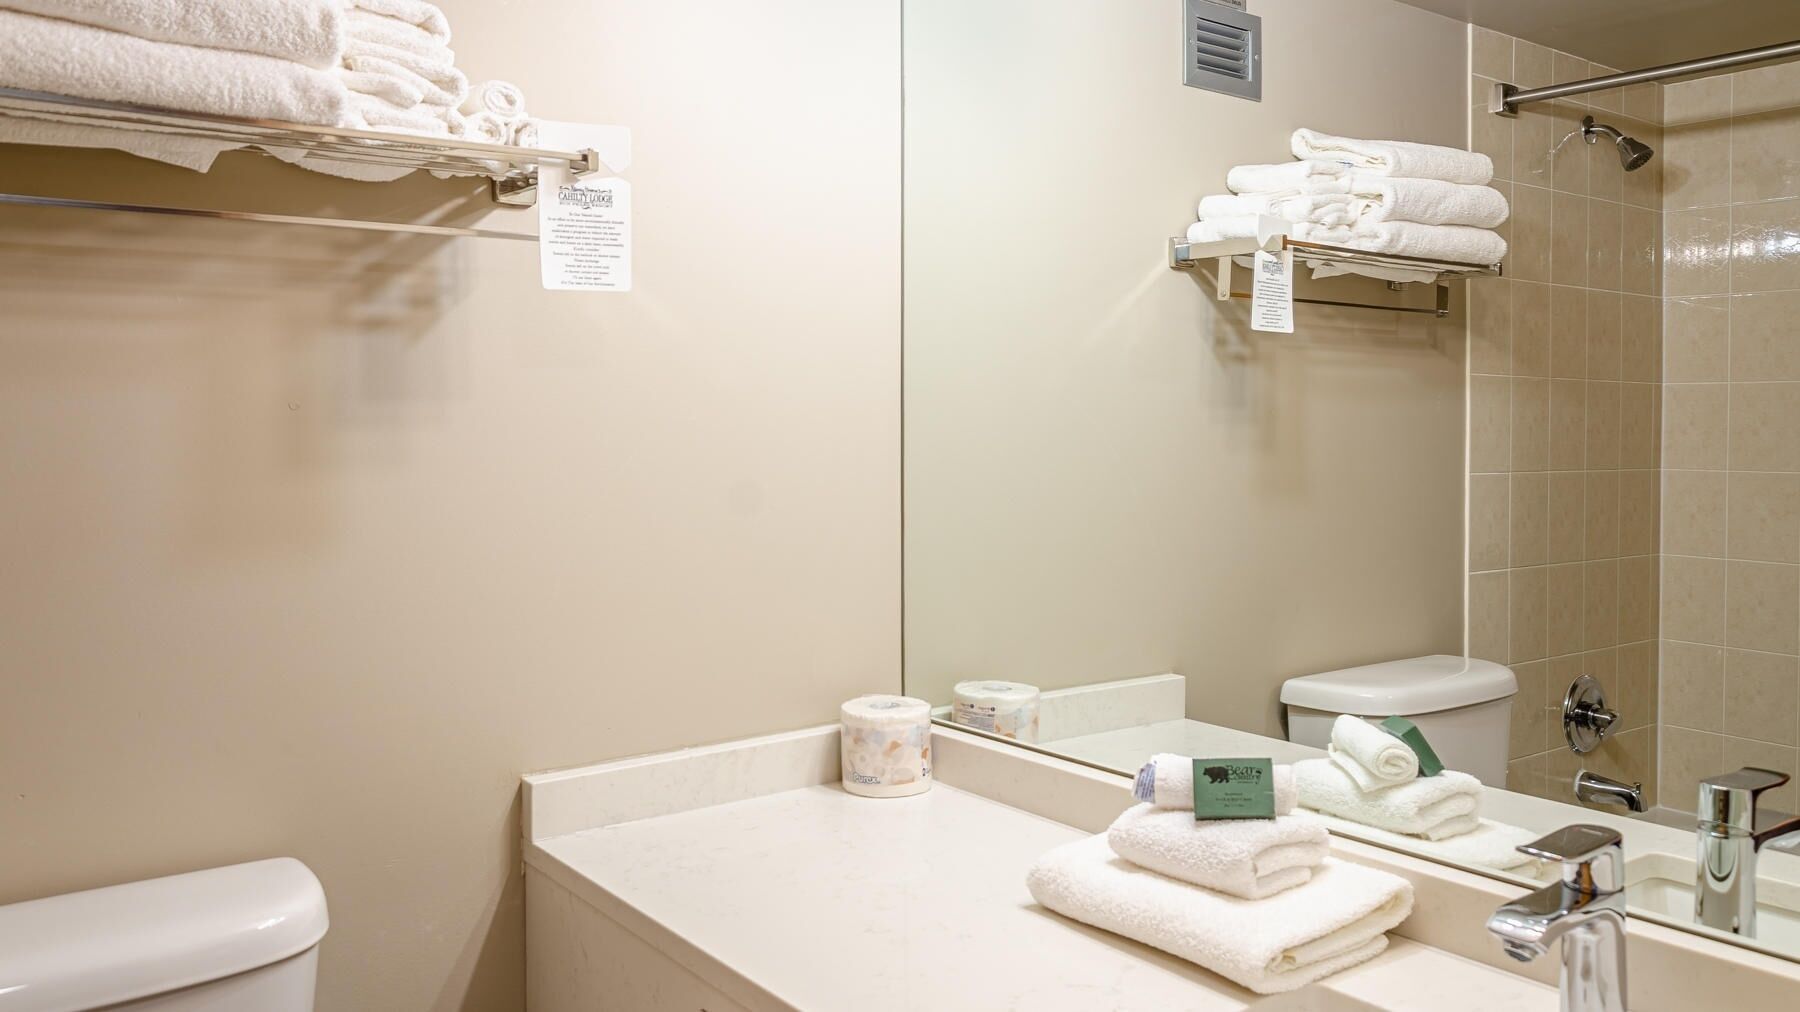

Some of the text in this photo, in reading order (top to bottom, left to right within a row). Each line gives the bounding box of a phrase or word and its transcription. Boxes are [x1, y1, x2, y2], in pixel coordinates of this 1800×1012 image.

[559, 191, 613, 204] CAHILTY LODGE
[1226, 765, 1256, 776] Bear
